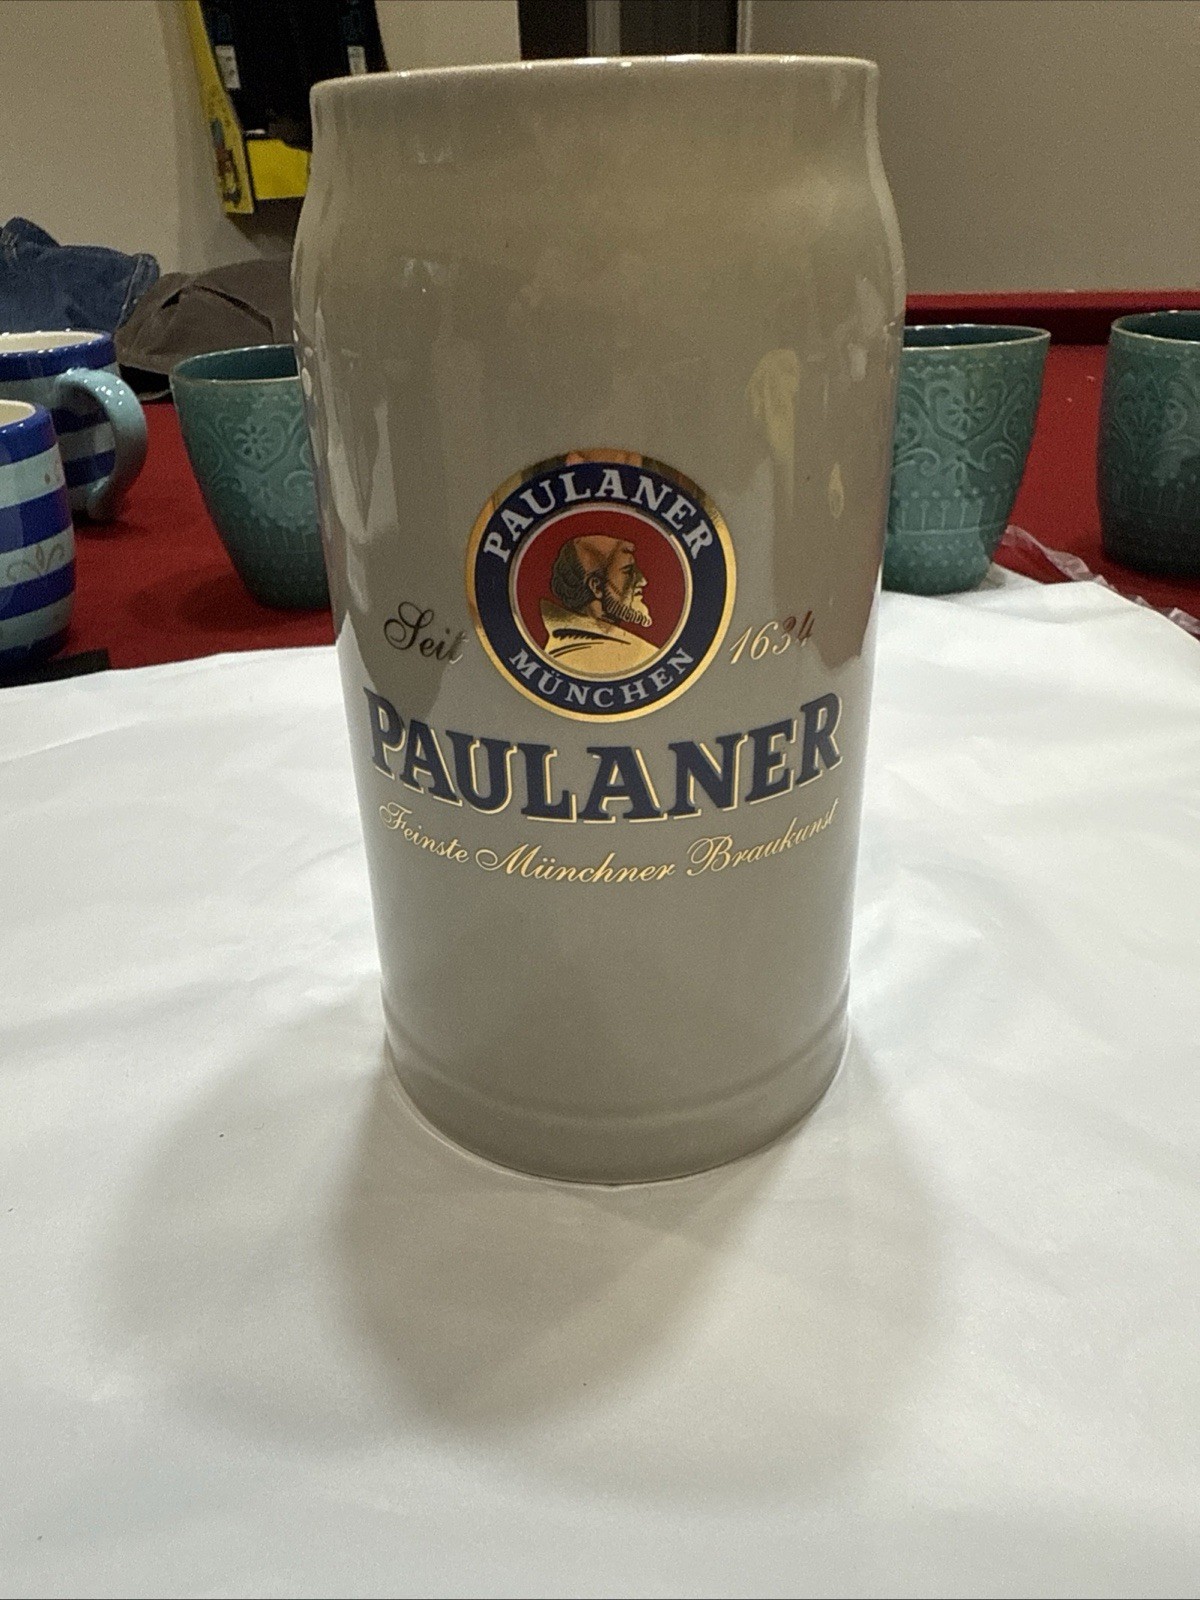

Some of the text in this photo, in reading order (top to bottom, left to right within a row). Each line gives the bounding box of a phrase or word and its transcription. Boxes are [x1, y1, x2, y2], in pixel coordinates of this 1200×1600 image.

[483, 468, 714, 563] PAULANER
[383, 601, 814, 665] Seit 1634
[509, 648, 695, 708] MÜNCHEN
[363, 686, 844, 824] PAULANER
[379, 797, 841, 883] Feinste Münchner Braukunst
